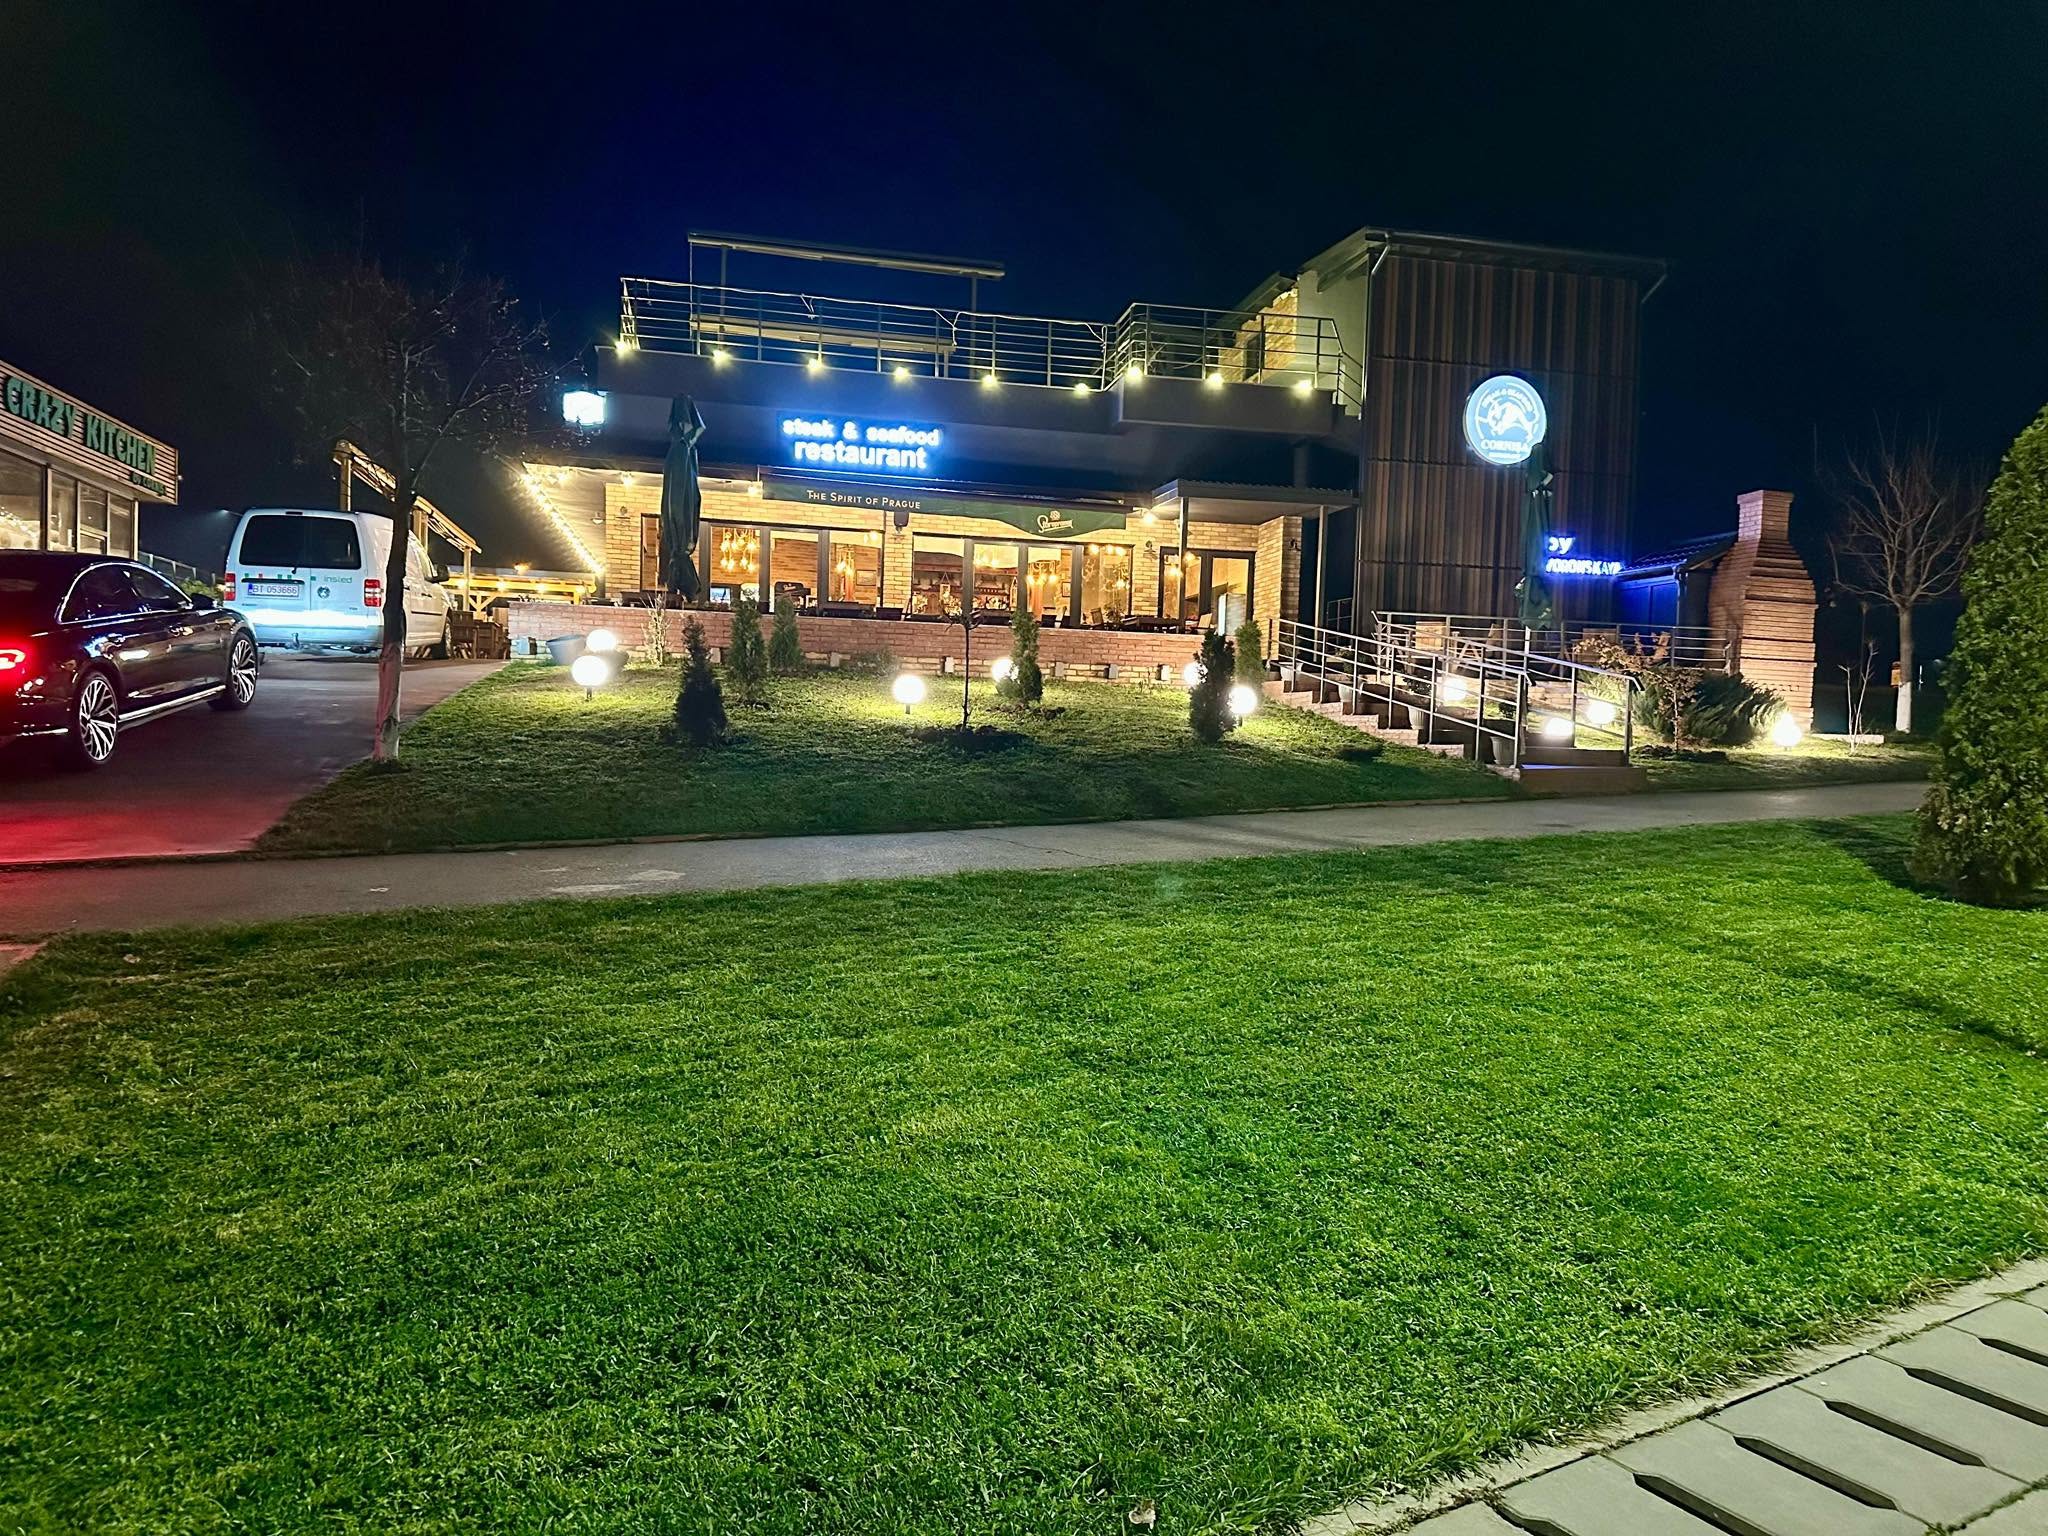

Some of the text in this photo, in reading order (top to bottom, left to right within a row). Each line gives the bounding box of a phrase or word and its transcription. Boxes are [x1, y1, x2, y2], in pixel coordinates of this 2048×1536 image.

[6, 376, 157, 477] CRAZY KITCHEN
[782, 417, 940, 446] steak & seafood
[794, 440, 927, 469] restaurant
[806, 489, 921, 510] THE SPIRIT OF PRAGUE
